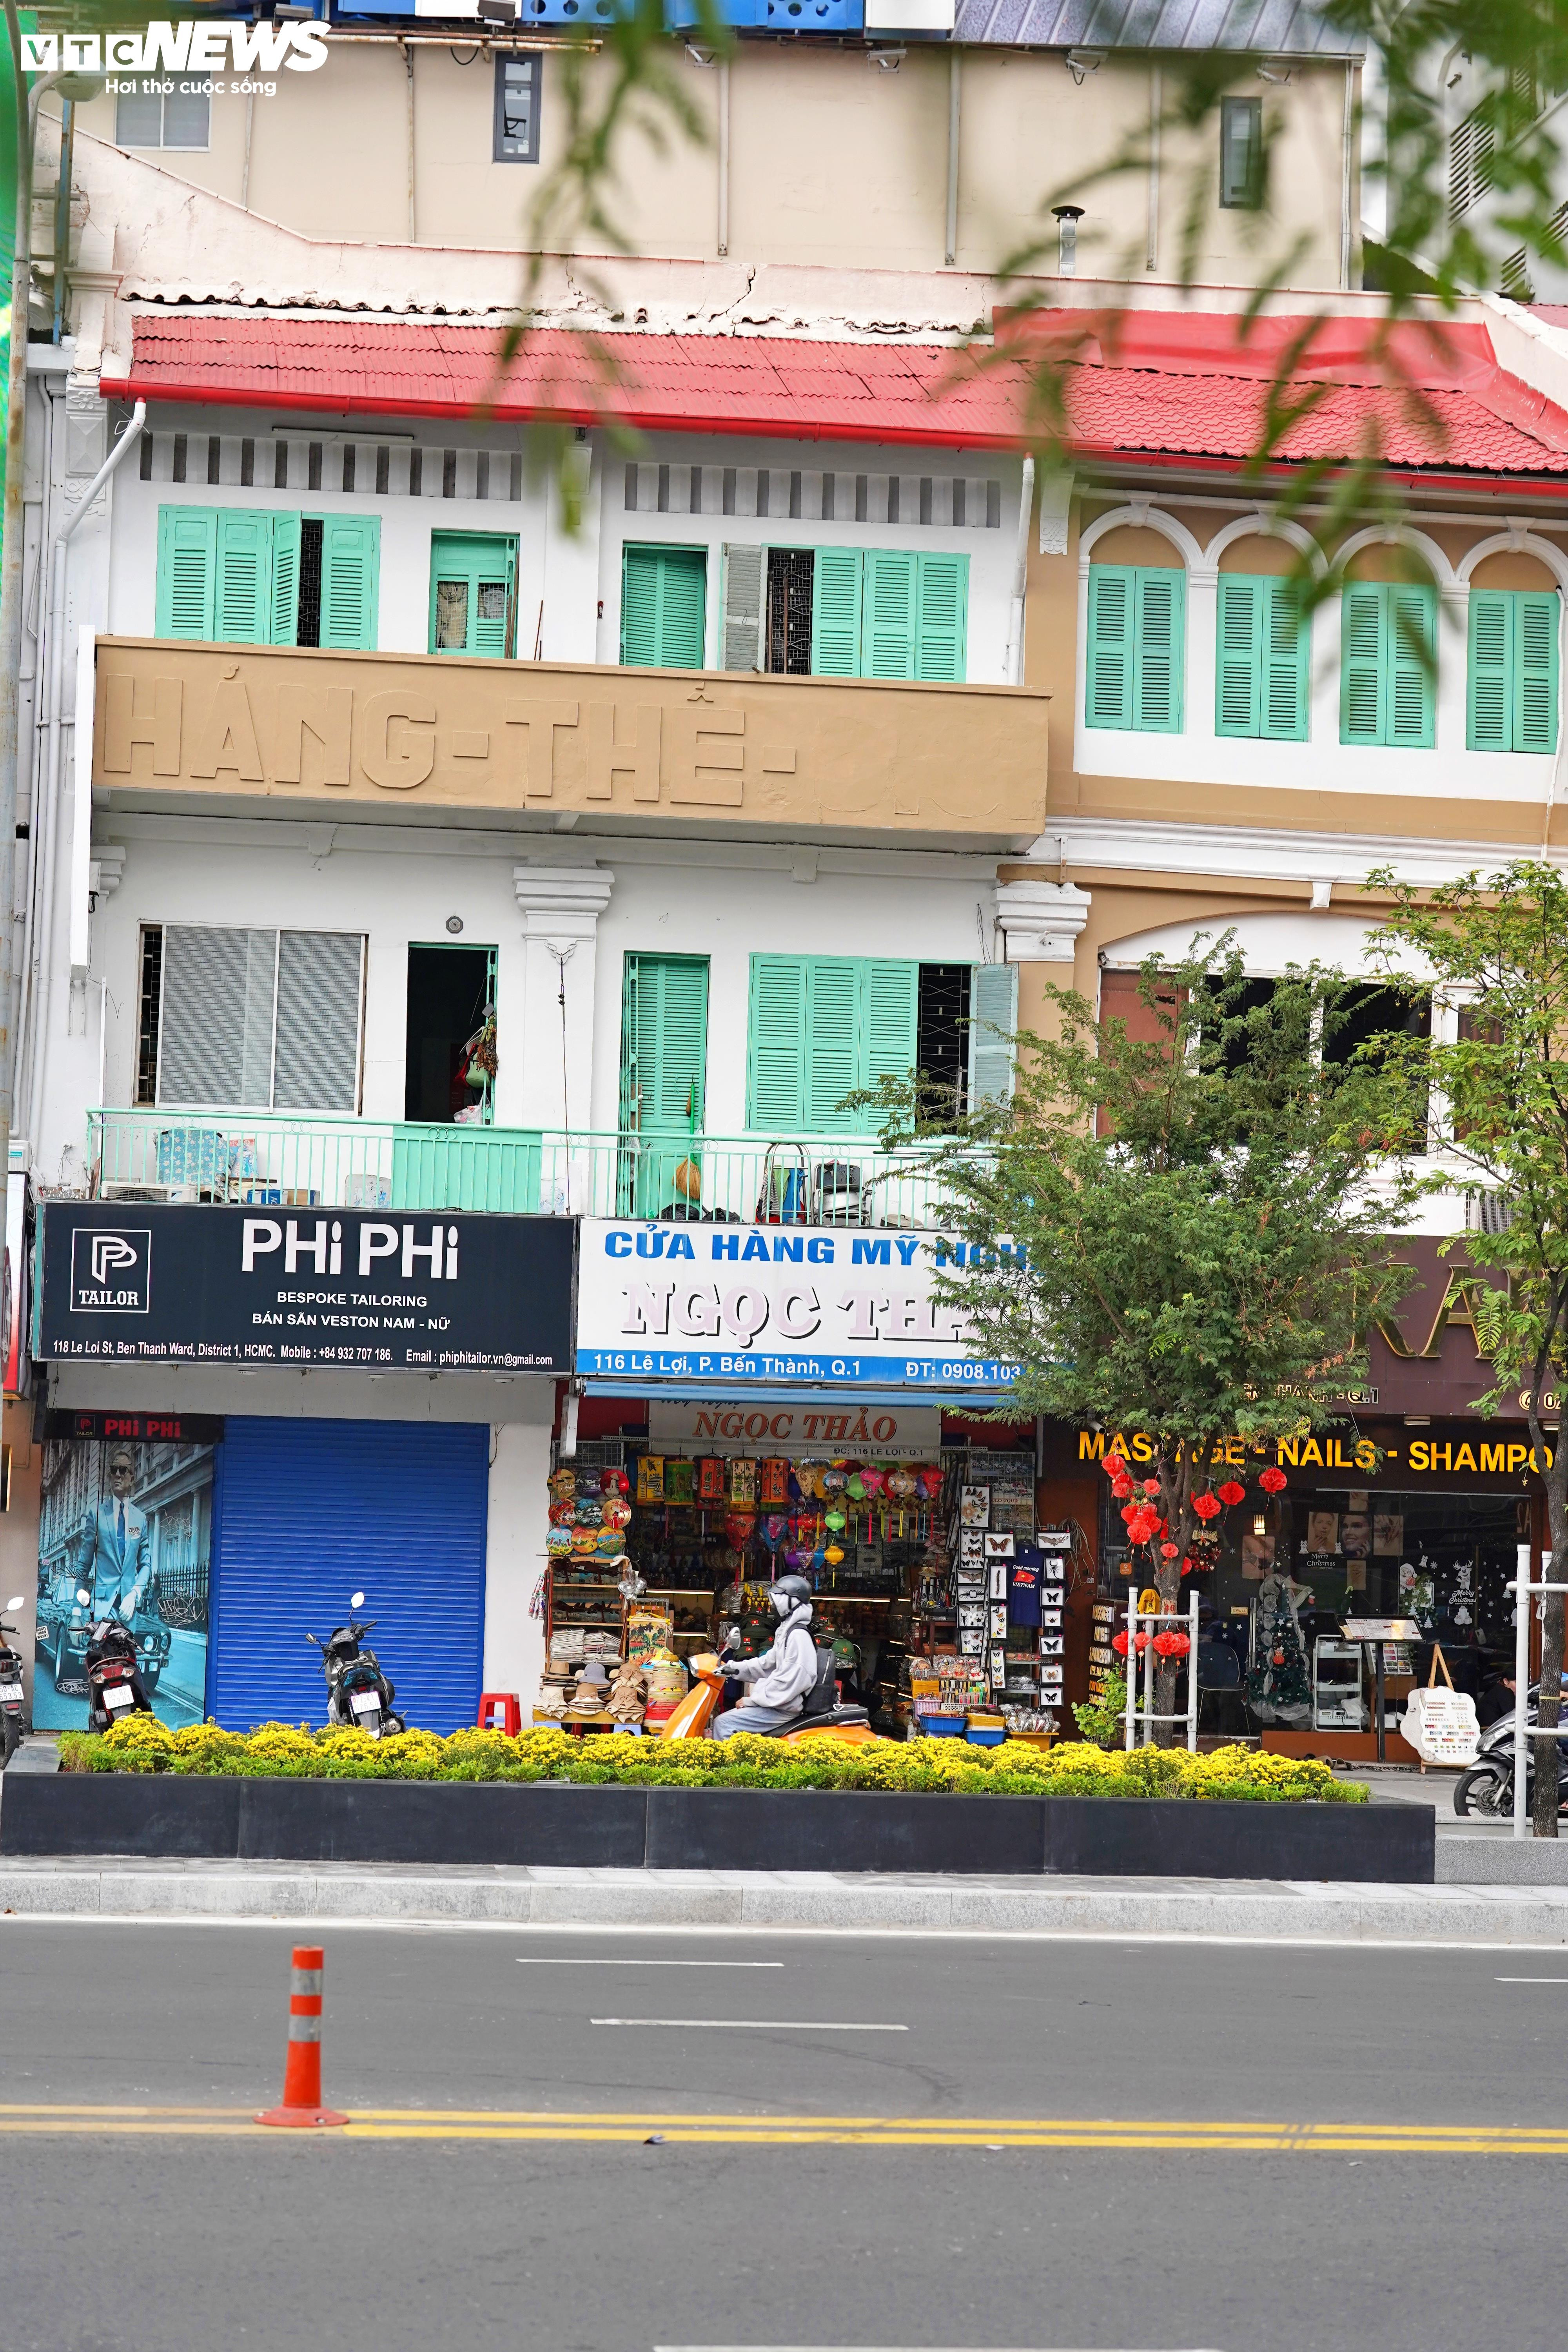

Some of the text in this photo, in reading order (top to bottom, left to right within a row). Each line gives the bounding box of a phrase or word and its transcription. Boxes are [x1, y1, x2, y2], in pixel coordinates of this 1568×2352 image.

[605, 1224, 695, 1259] CỬA
[712, 1230, 834, 1263] HÀNG
[852, 1235, 920, 1266] MỸ
[78, 1290, 139, 1305] TAILOR
[277, 1292, 427, 1307] BESPOKE TAILORING
[252, 1311, 282, 1324] BÁN
[321, 1315, 379, 1327] VESTON
[383, 1318, 414, 1328] NAM
[428, 1317, 450, 1330] NỮ
[621, 1282, 821, 1349] NGỌC
[53, 1340, 69, 1353] 118
[71, 1341, 82, 1353] Le
[85, 1341, 100, 1354] Loi
[102, 1341, 114, 1356] St,
[117, 1341, 135, 1354] Ben
[138, 1342, 167, 1355] Thanh
[169, 1343, 195, 1357] Ward,
[198, 1343, 231, 1356] District
[234, 1345, 241, 1358] 1,
[244, 1345, 275, 1357] HCMC.
[281, 1345, 311, 1358] Mobile
[319, 1347, 335, 1359] +84
[338, 1347, 354, 1359] 932
[356, 1348, 372, 1360] 707
[375, 1348, 393, 1361] 186.
[406, 1349, 431, 1362] Email
[439, 1350, 552, 1367] phiphitailor.vn@gmail.com
[594, 1354, 625, 1369] 116
[632, 1355, 653, 1370] Lê
[660, 1356, 692, 1373] Lợi,
[700, 1359, 713, 1372] P.
[720, 1356, 756, 1373] Bến
[763, 1358, 825, 1376] Thành,
[831, 1360, 860, 1376] Q.1
[906, 1362, 935, 1377] ĐT:
[692, 1406, 897, 1445] NGỌC THẢO
[1278, 1438, 1375, 1468] NAILS
